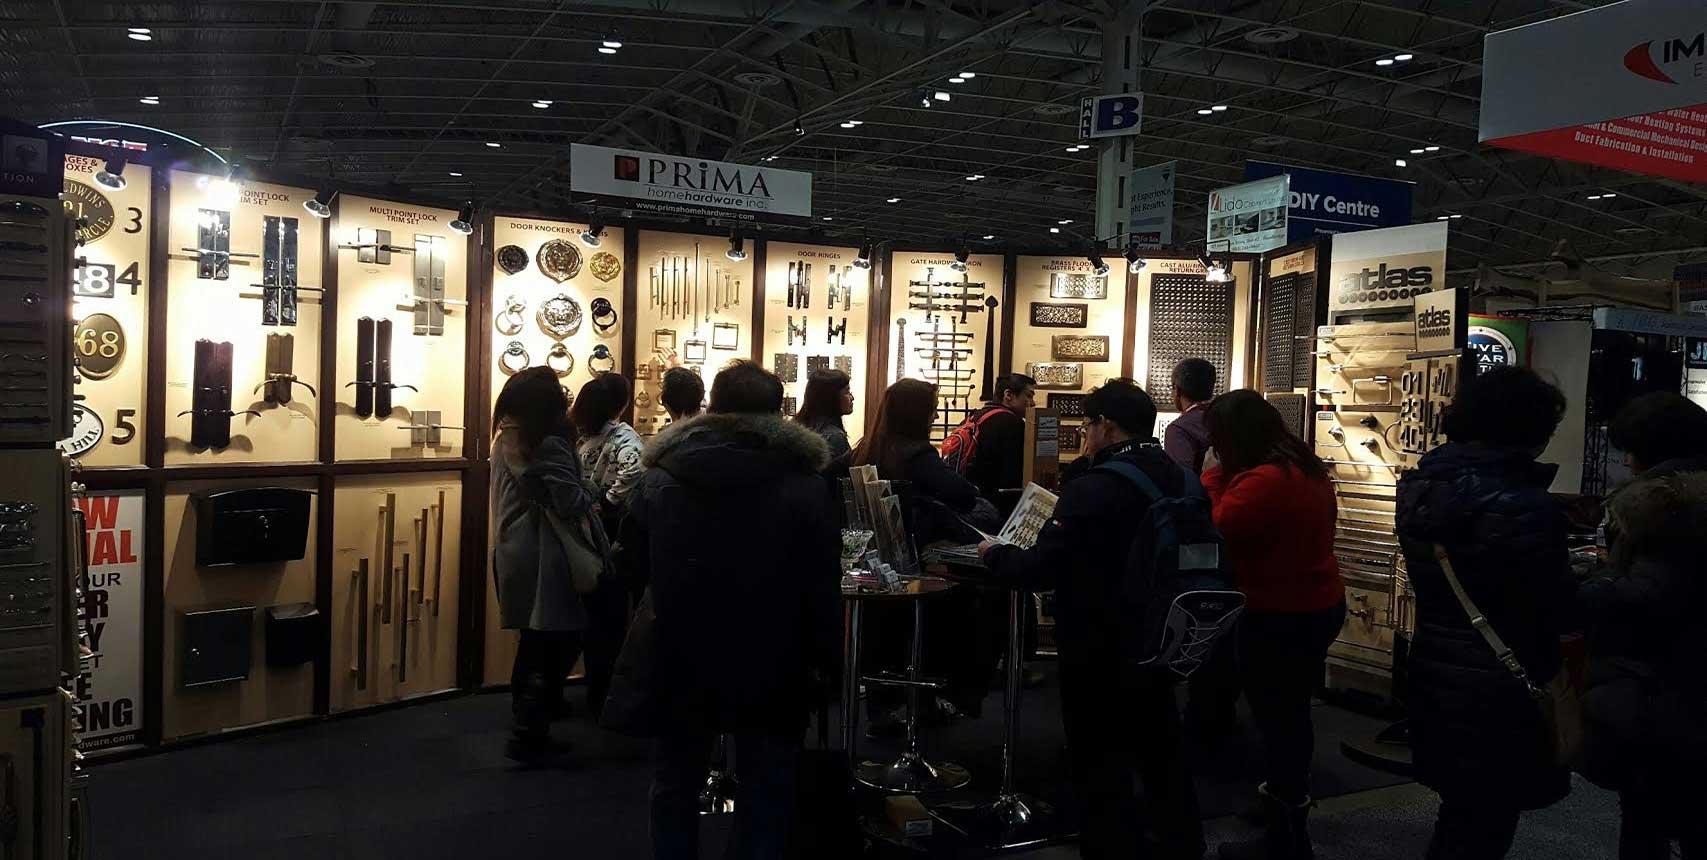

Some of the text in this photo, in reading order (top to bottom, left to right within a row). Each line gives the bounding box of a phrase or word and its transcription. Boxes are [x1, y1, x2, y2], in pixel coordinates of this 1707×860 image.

[1081, 96, 1140, 138] HALL B
[1645, 115, 1674, 131] Heating
[1575, 130, 1695, 164] Duct Fabrication & Installation
[1607, 122, 1651, 140] Commercial
[1650, 132, 1691, 149] Mechanical
[90, 158, 98, 167] &
[252, 197, 269, 206] SET
[267, 192, 290, 202] LOCK
[1219, 195, 1244, 213] Lido
[1289, 191, 1320, 211] DIY
[1322, 195, 1381, 218] Centre
[124, 207, 143, 233] 3
[369, 205, 438, 222] MULTI POINT LOCK
[386, 214, 420, 225] TRIM SET
[510, 222, 533, 230] DOOR
[534, 225, 575, 234] KNOCKERS
[797, 250, 841, 260] DOOR HINGES
[83, 264, 111, 295] 8
[115, 261, 143, 296] 4
[1169, 266, 1194, 274] RETURN
[1338, 263, 1433, 291] atlas
[1417, 305, 1451, 329] atlas
[77, 328, 120, 359] 68
[111, 408, 137, 445] 5
